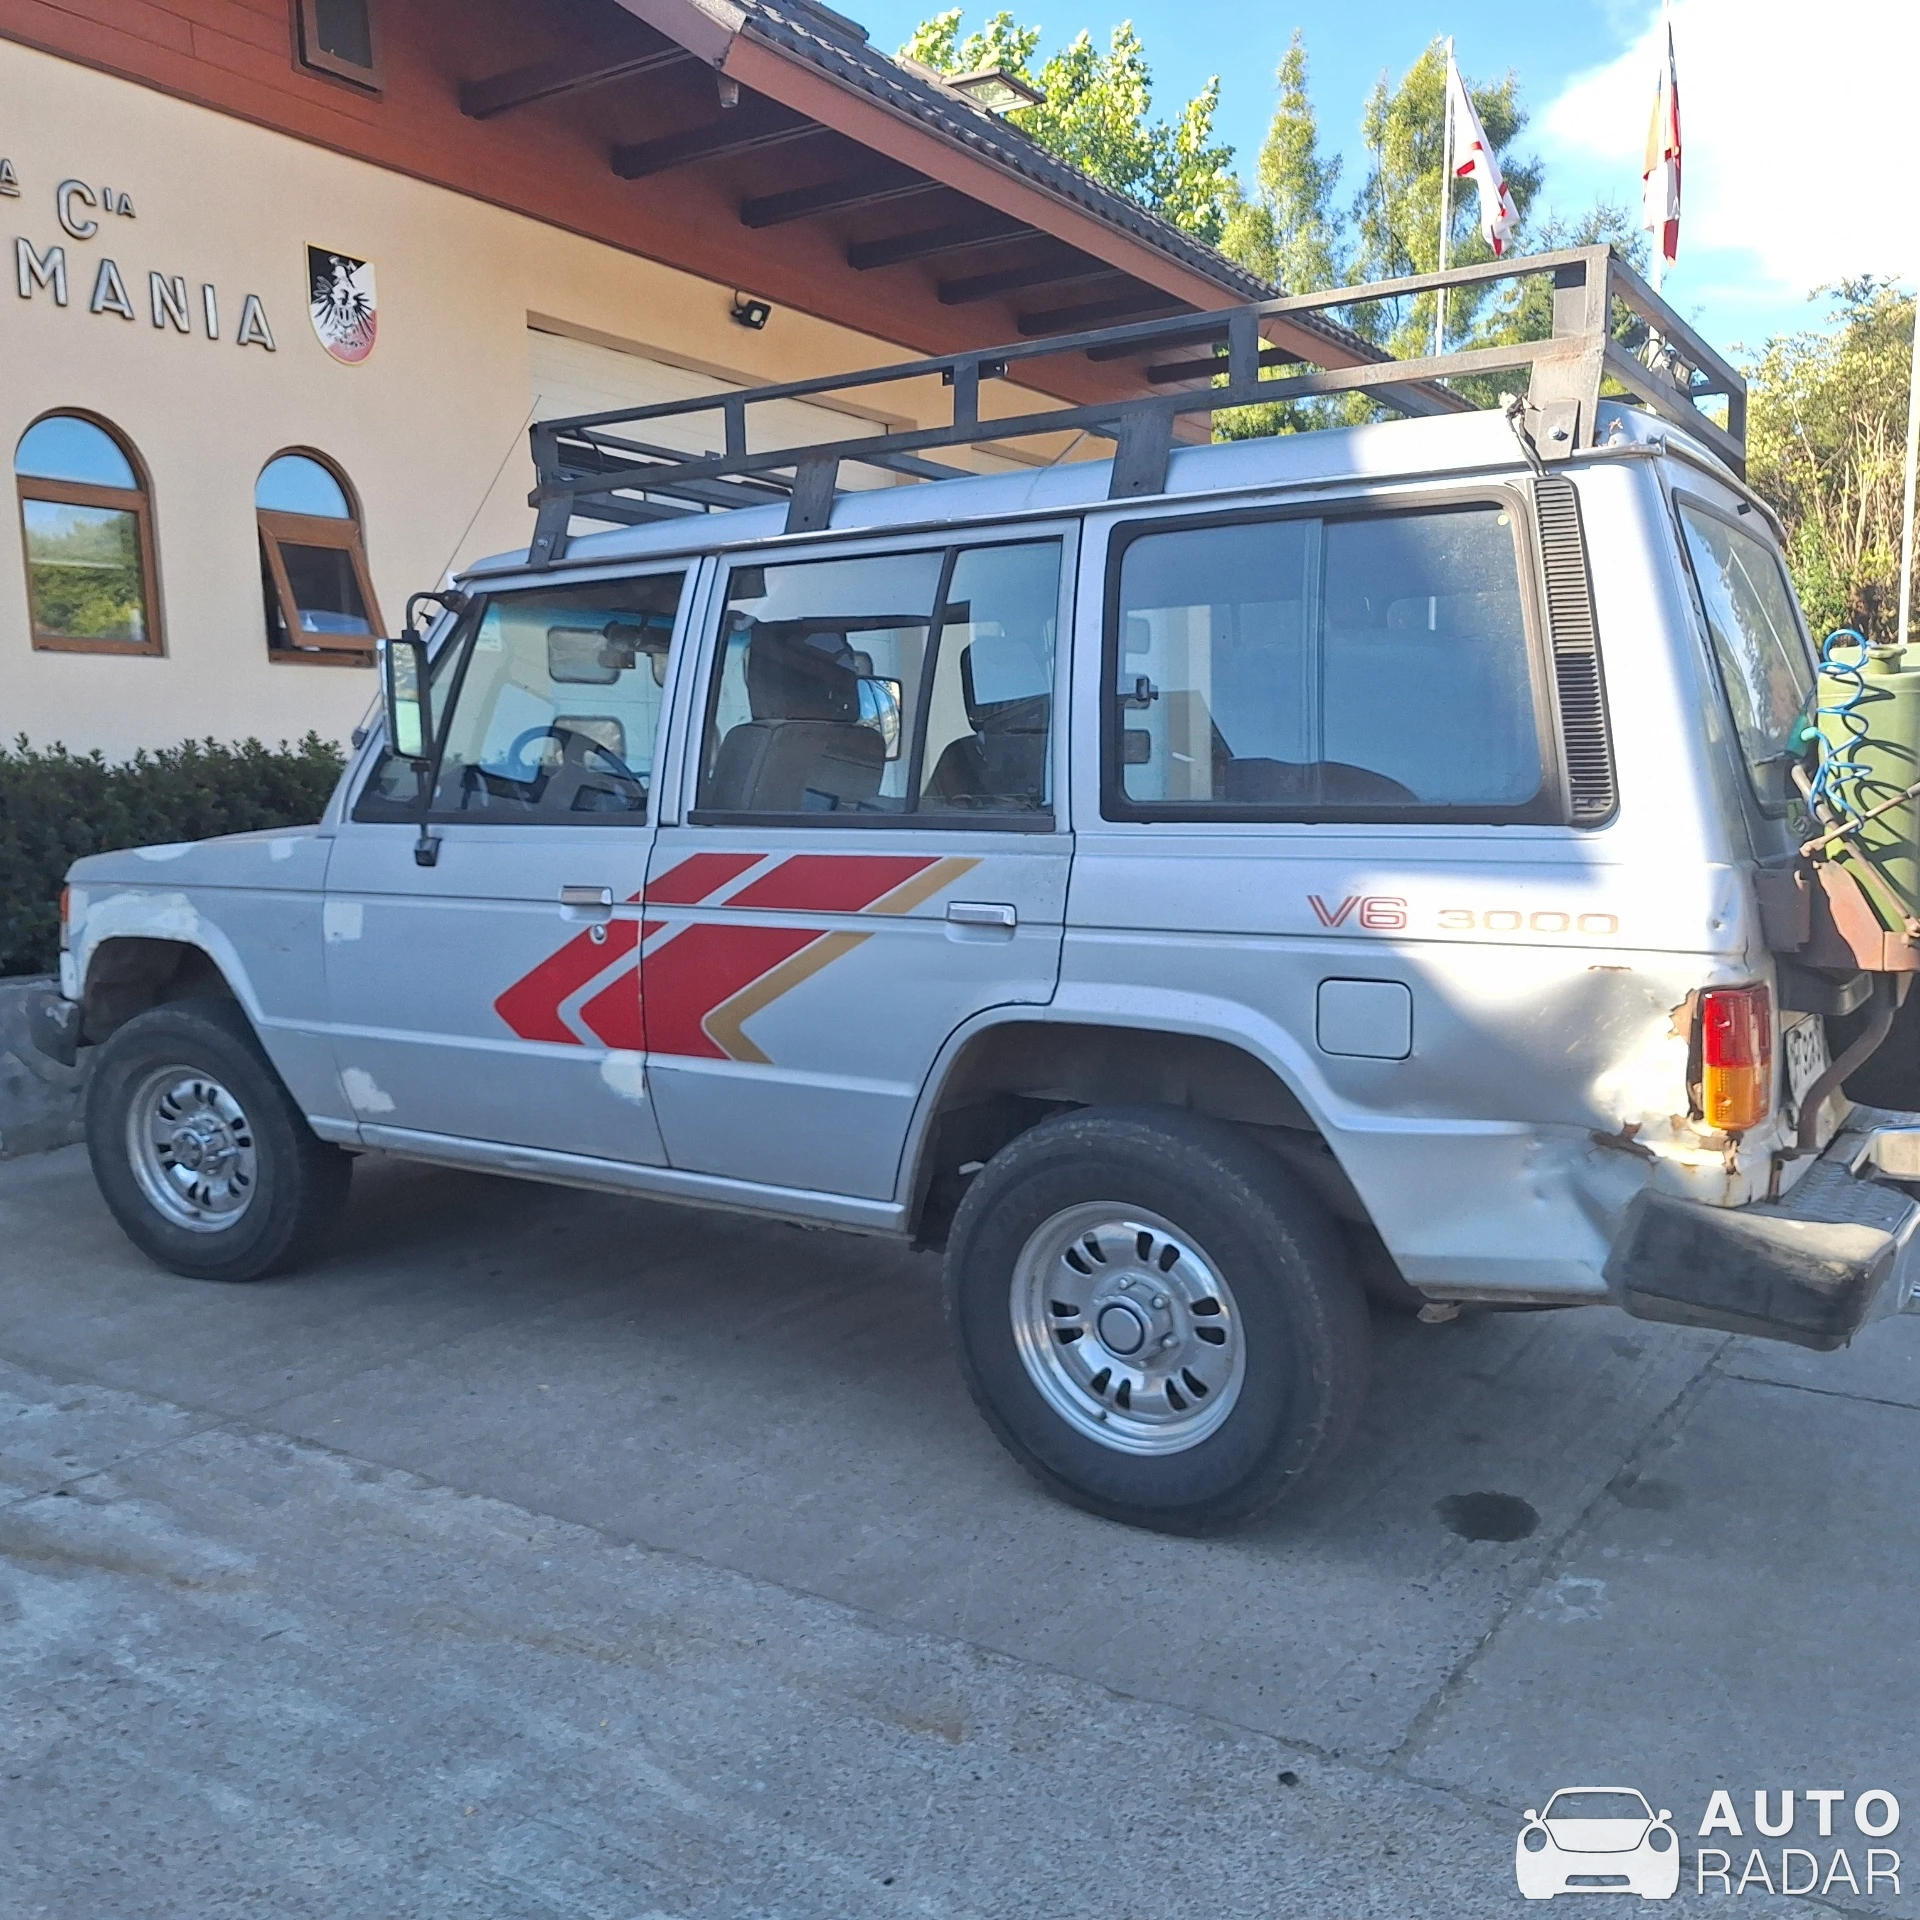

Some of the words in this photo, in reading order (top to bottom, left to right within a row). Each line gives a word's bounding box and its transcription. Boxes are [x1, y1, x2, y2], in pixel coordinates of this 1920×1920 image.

[16, 237, 276, 351] MANIA
[1306, 895, 1407, 929] V6
[1437, 909, 1618, 934] 3000
